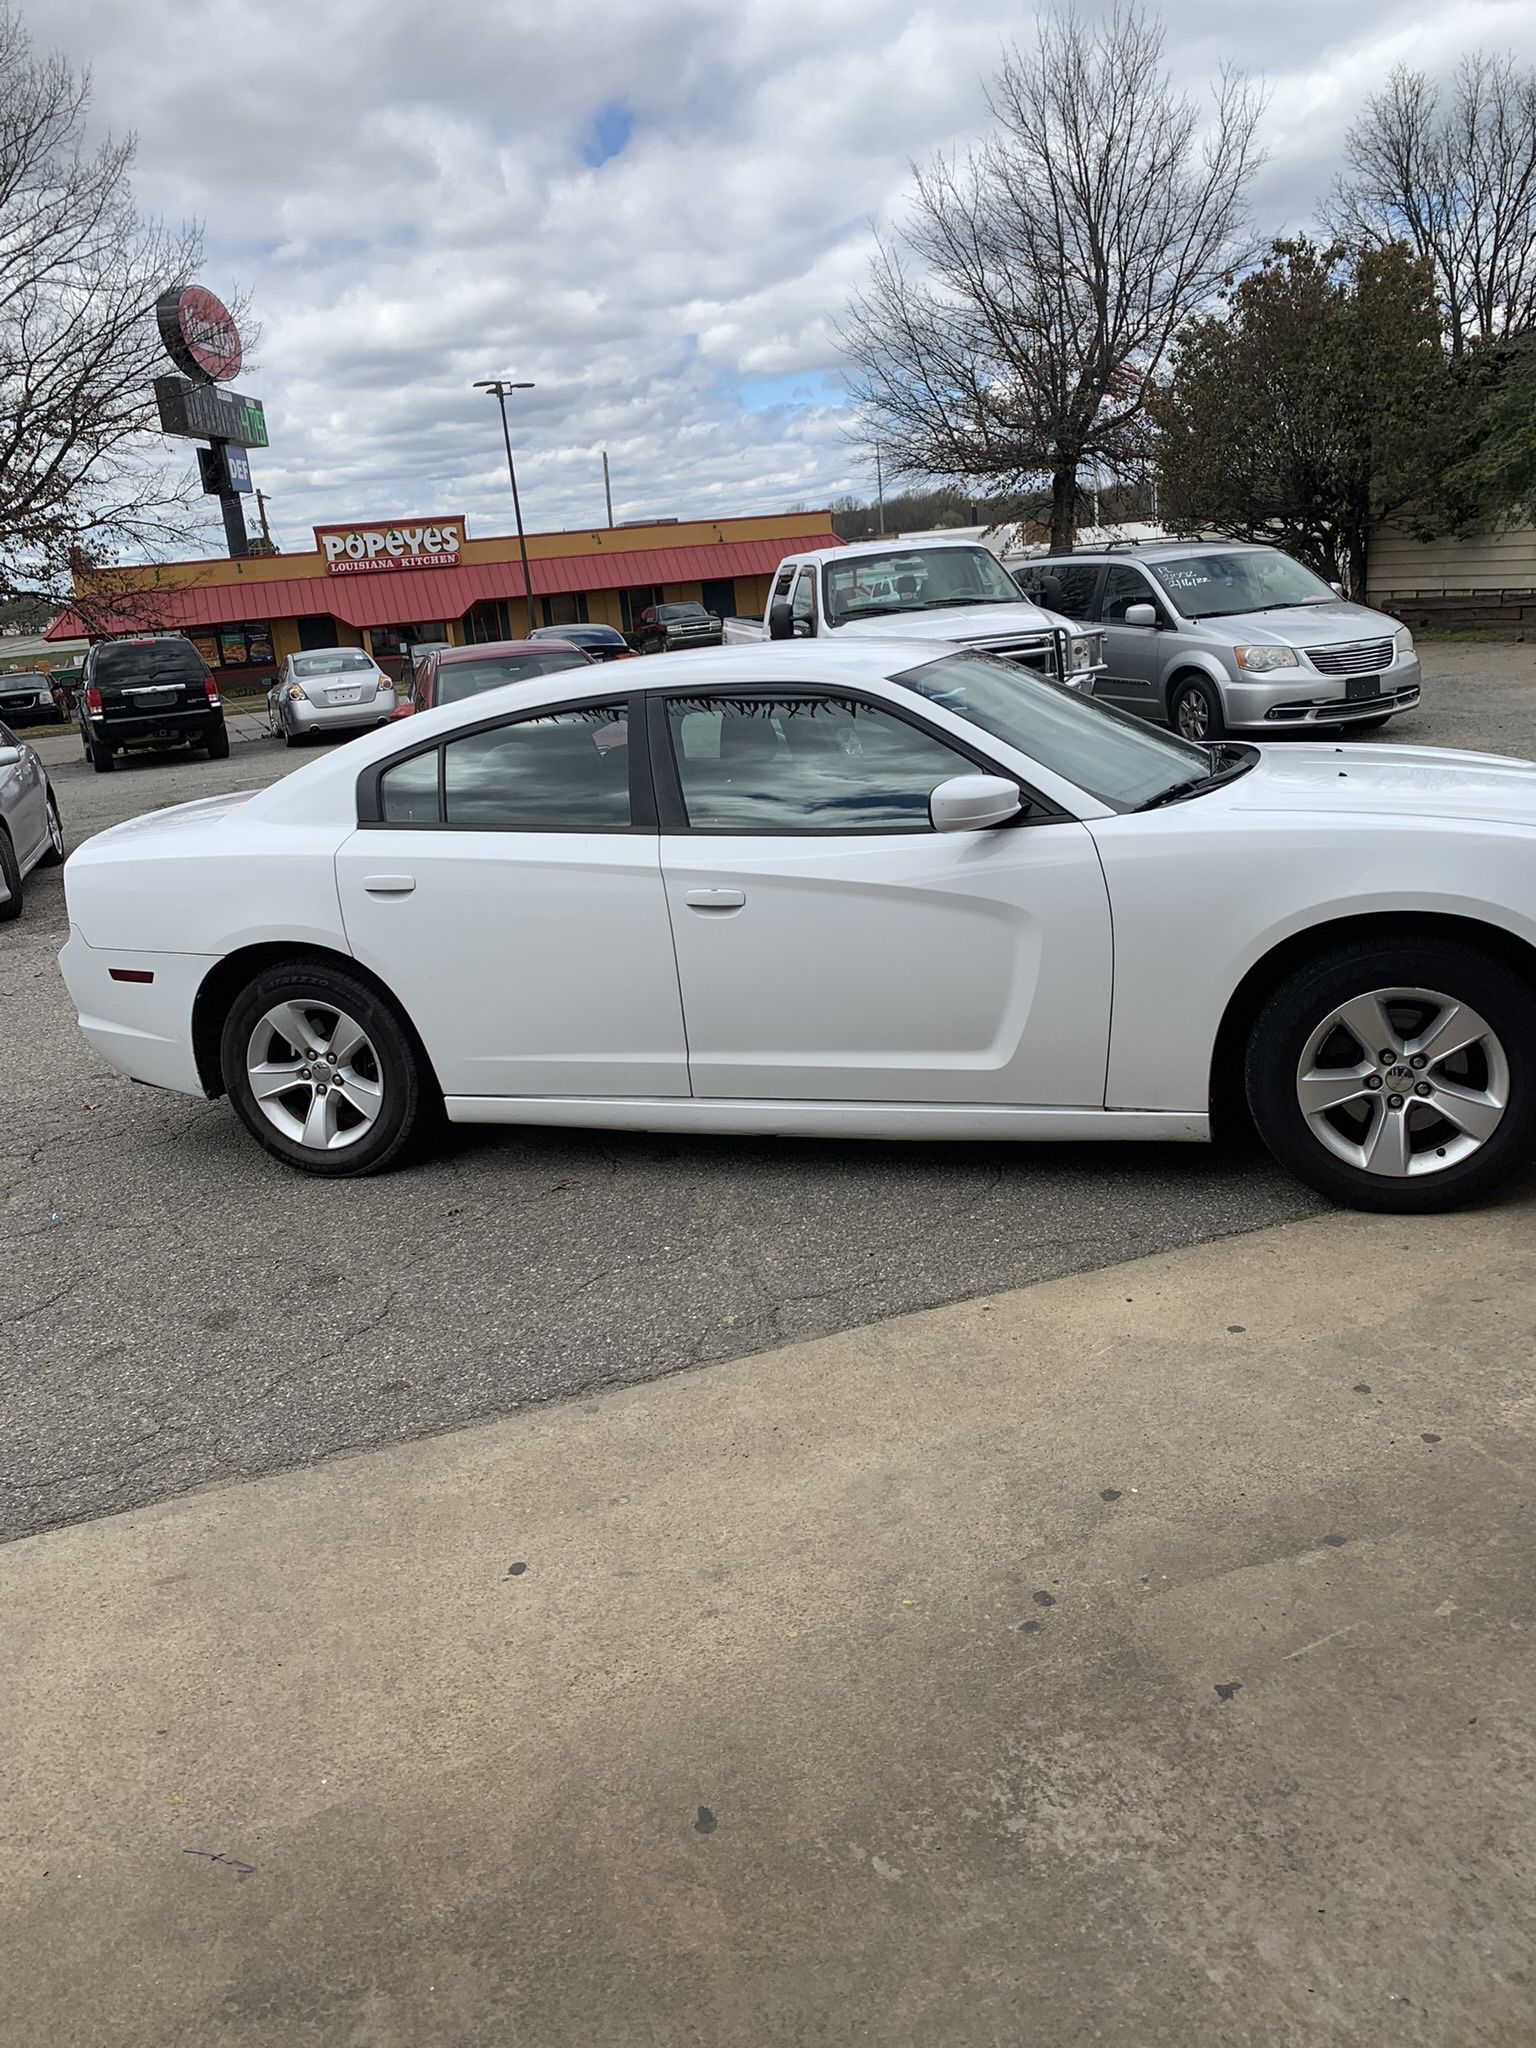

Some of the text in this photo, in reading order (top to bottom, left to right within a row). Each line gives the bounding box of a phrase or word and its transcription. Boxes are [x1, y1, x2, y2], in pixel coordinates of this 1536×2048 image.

[228, 457, 249, 480] DEF
[329, 554, 457, 573] LOUISIANA KITCHEN
